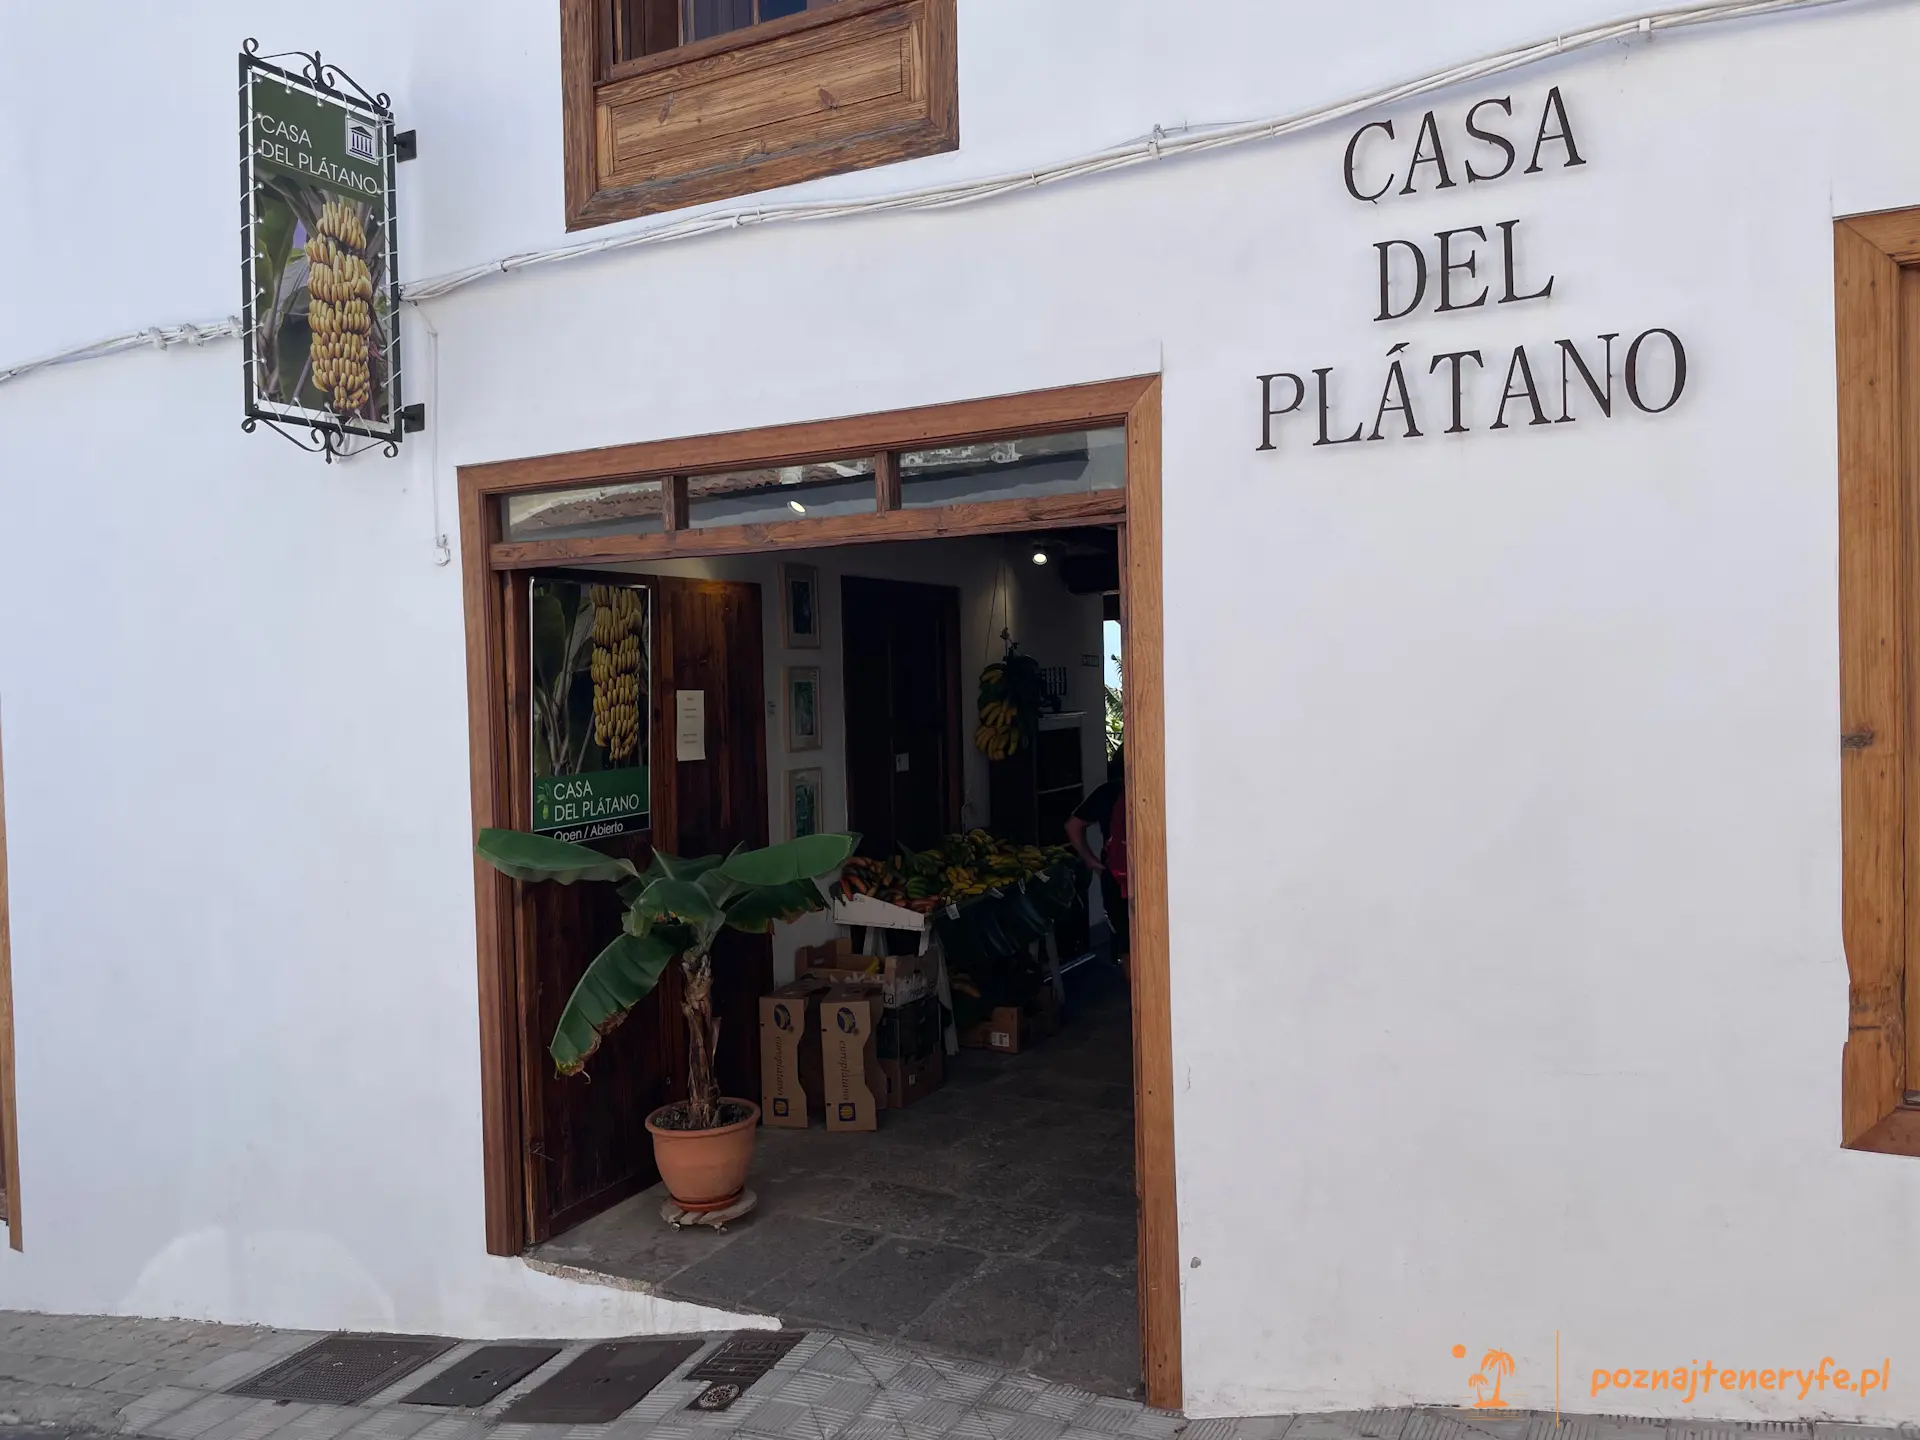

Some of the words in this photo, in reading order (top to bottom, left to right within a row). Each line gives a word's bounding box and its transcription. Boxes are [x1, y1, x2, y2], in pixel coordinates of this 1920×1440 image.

[259, 114, 313, 148] CASA
[1343, 86, 1587, 204] CASA
[260, 139, 294, 167] DEL
[298, 152, 378, 194] PLÁTANO
[1372, 219, 1555, 322] DEL
[1256, 328, 1687, 451] PLÁTANO
[553, 779, 593, 801] CASA
[554, 803, 579, 822] DEL
[582, 793, 640, 818] PLÁTANO
[553, 829, 582, 842] Open
[583, 826, 589, 839] /
[590, 821, 624, 838] Abierto
